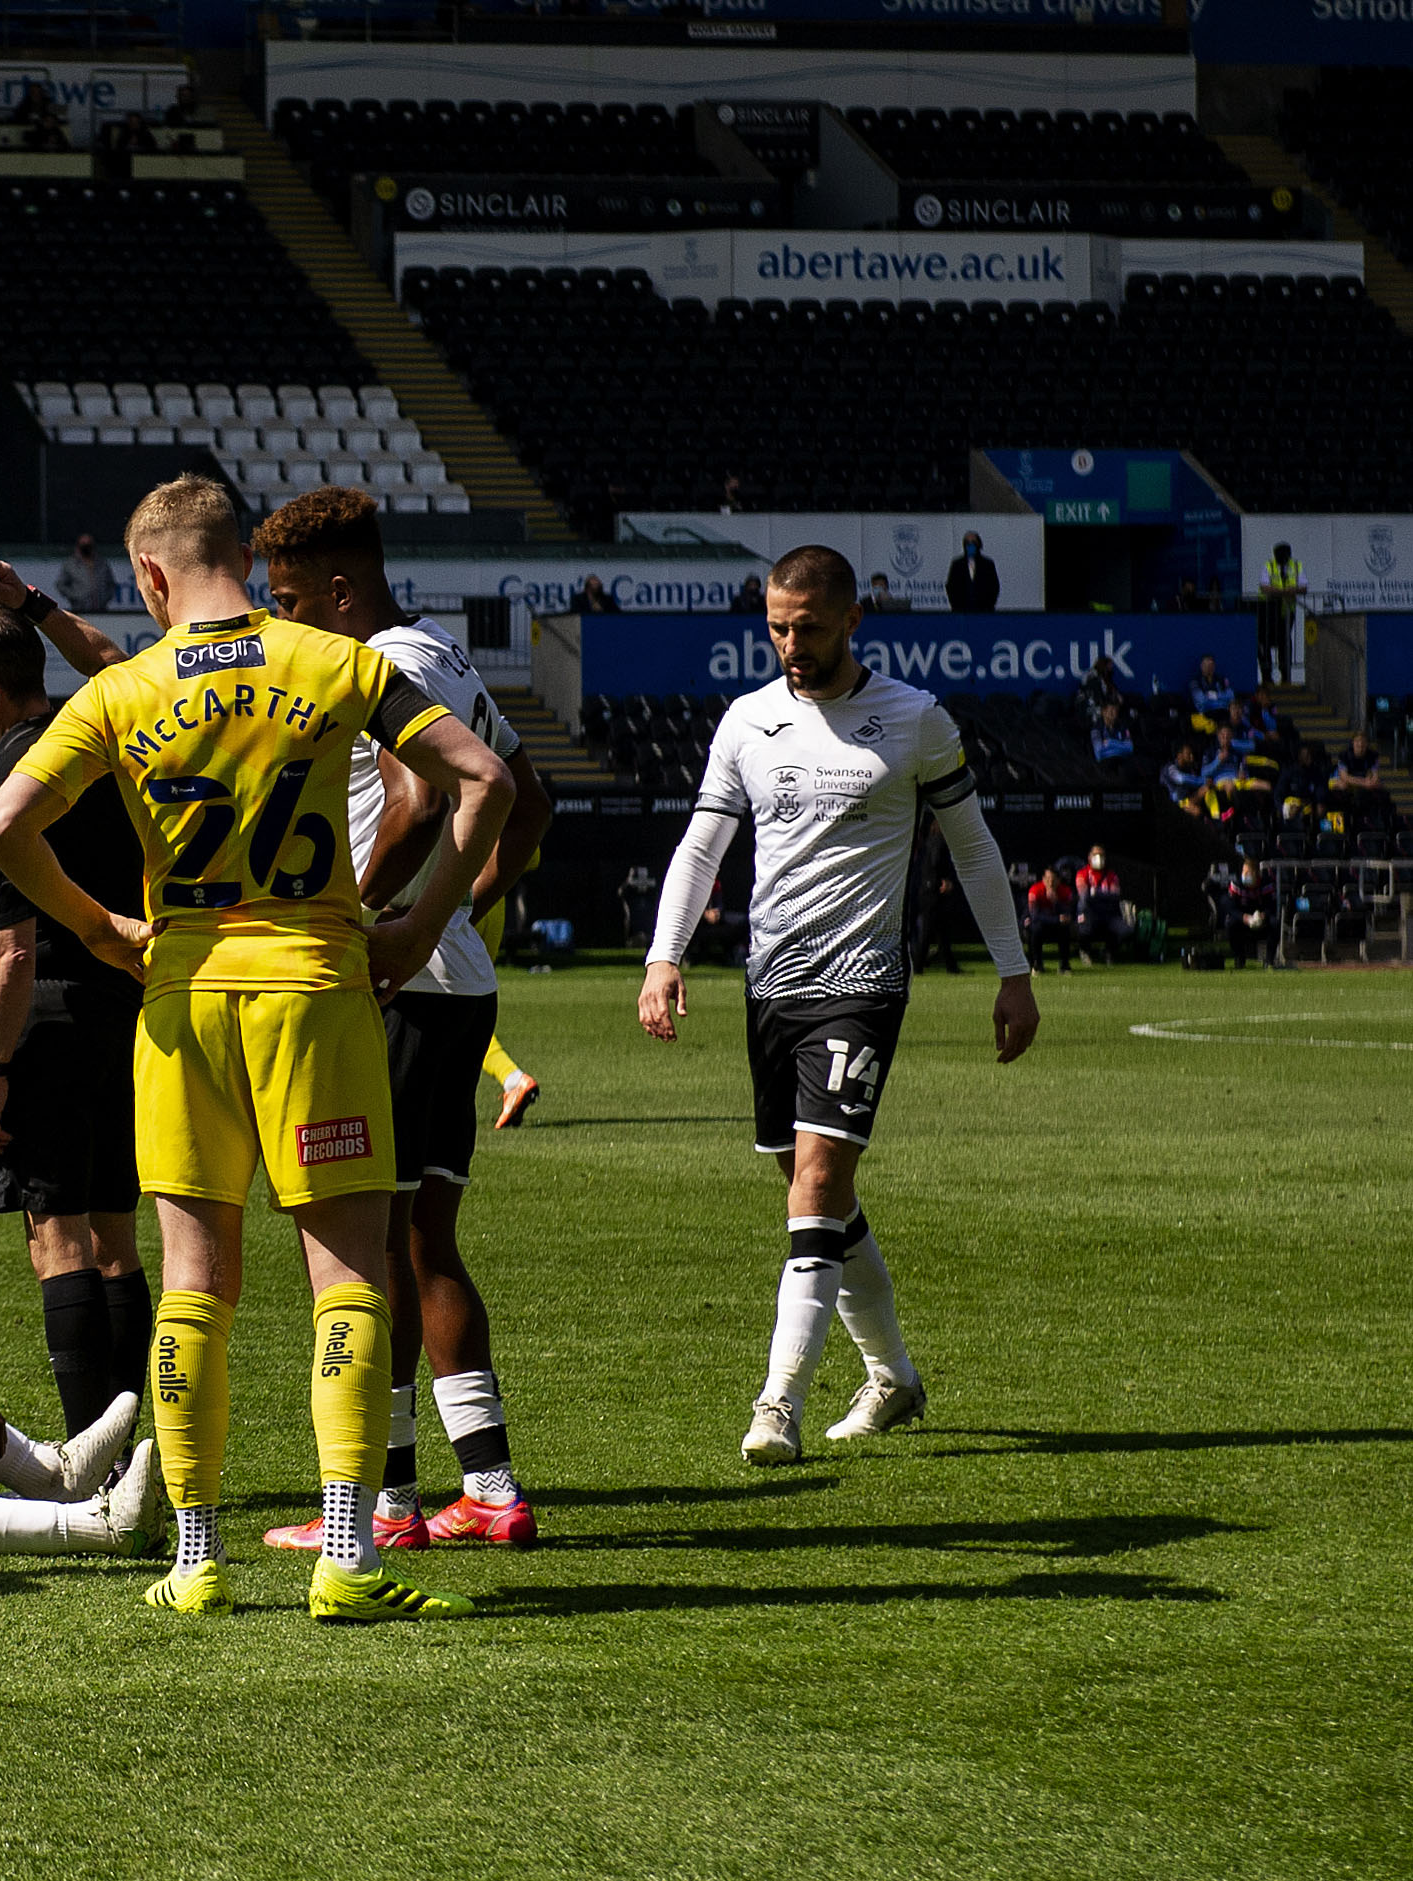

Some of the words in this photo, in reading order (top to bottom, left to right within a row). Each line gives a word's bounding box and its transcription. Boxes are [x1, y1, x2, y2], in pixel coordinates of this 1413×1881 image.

[440, 193, 568, 217] SINCLAIR
[947, 199, 1072, 224] SINCLAIR
[757, 243, 1061, 282] abertawe.ac.uk
[1055, 502, 1090, 522] EXIT
[178, 640, 262, 668] origin
[815, 766, 873, 779] Swansea
[814, 779, 873, 794] University
[812, 812, 868, 824] Abertawe
[815, 799, 868, 813] Prifysgol
[146, 758, 336, 908] 26
[826, 1038, 879, 1101] 14
[301, 1124, 337, 1144] CHERRY
[341, 1121, 363, 1137] RED
[303, 1137, 365, 1163] RECORDS
